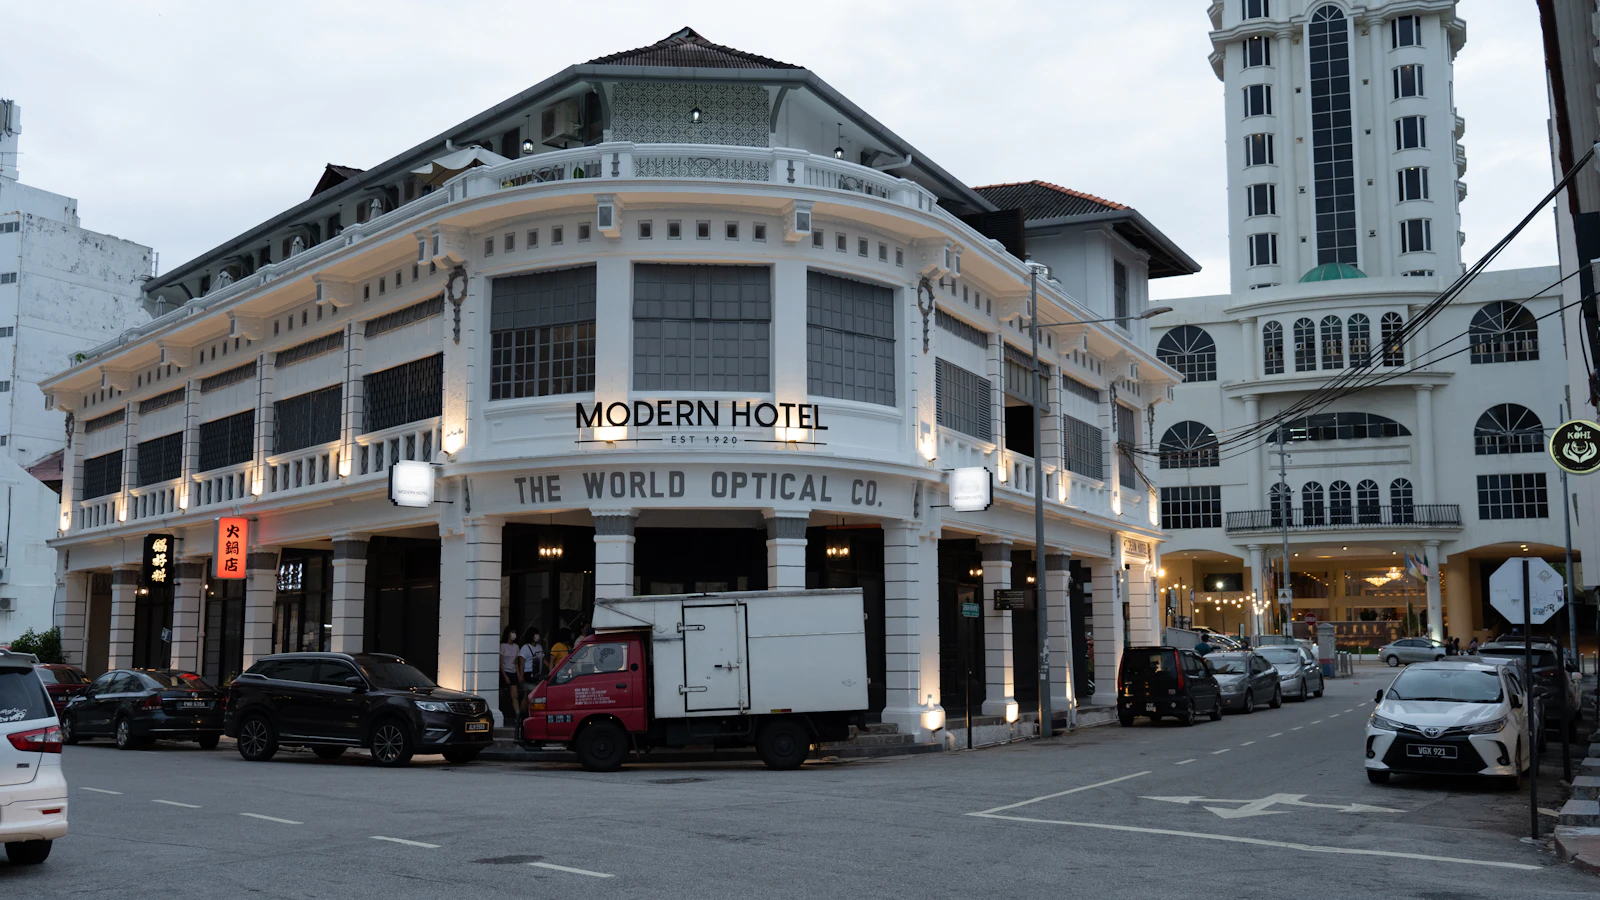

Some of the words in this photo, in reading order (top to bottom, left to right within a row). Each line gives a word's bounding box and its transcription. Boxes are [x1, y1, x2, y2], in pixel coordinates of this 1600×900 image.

[576, 400, 719, 428] MODERN
[731, 400, 828, 430] HOTEL
[671, 435, 695, 444] EST
[705, 435, 738, 444] 1920
[1567, 431, 1591, 439] KOHI
[514, 475, 562, 504] THE
[582, 470, 685, 499] WORLD
[711, 471, 832, 503] OPTICAL
[851, 479, 882, 507] CO.
[224, 525, 240, 572] 火鍋店
[1418, 747, 1431, 755] VGX
[1433, 747, 1446, 755] 921
